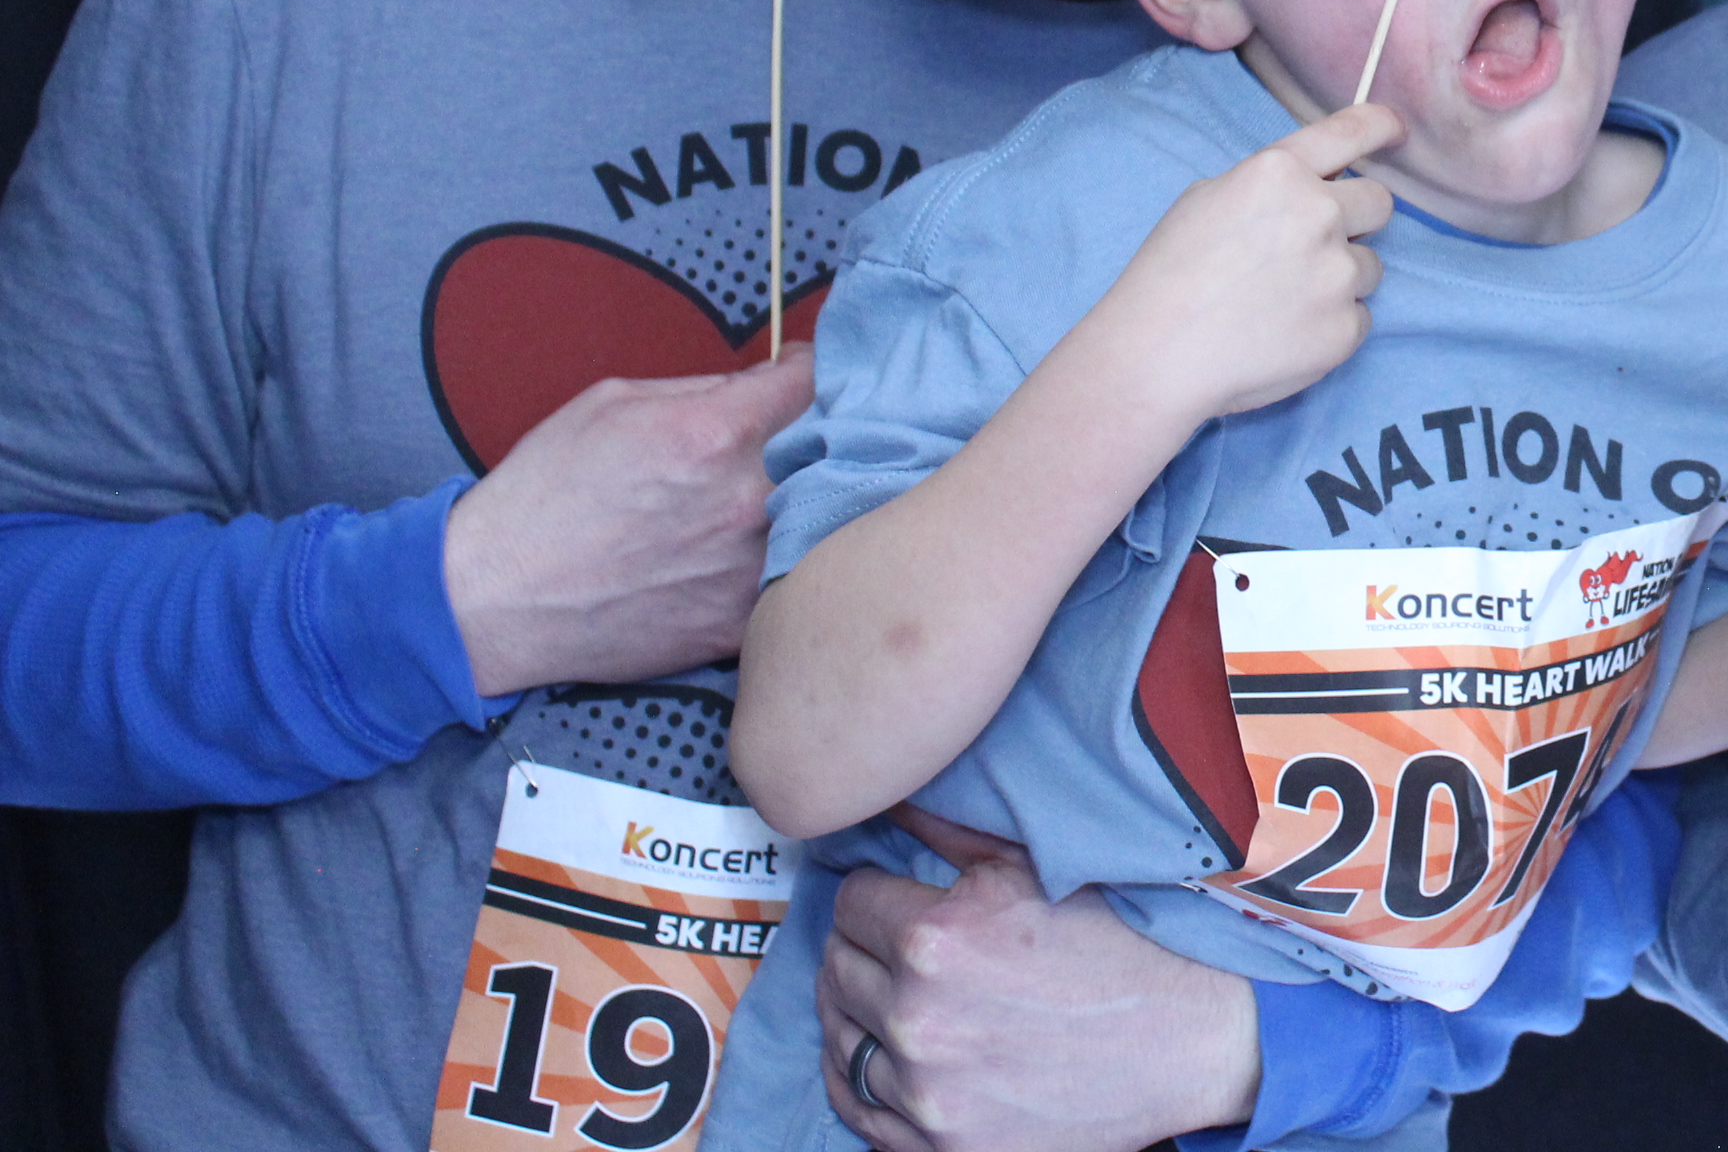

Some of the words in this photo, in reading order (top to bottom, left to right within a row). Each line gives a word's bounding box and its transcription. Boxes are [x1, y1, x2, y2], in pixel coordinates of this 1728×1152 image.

[1305, 405, 1624, 537] NATION
[1365, 584, 1533, 621] Koncert
[1419, 672, 1467, 705] 5K
[1477, 661, 1580, 707] HEART
[1584, 636, 1648, 686] WALK
[621, 821, 778, 874] Koncert
[655, 914, 706, 950] 5K
